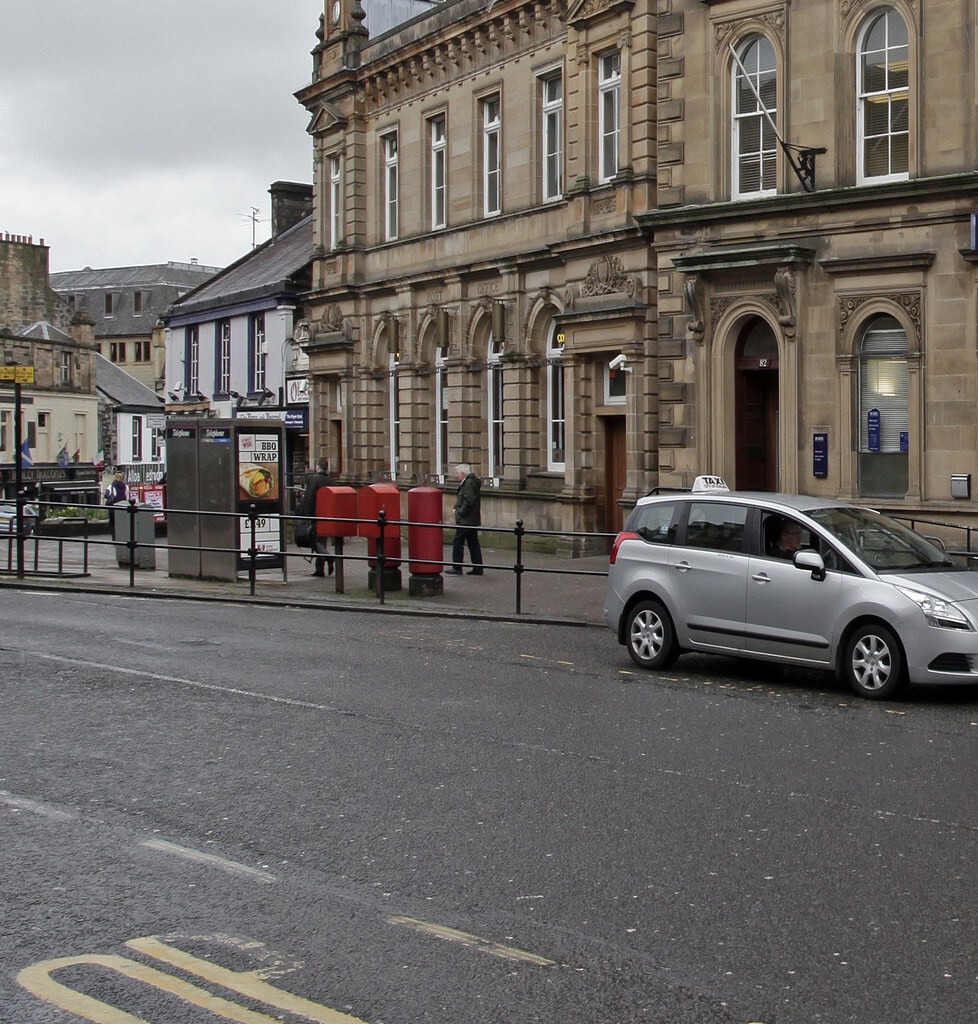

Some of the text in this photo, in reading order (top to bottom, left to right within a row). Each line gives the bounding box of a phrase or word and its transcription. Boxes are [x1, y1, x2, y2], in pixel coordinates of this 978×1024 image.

[759, 358, 767, 367] 82
[172, 428, 190, 438] Telephone
[205, 429, 225, 438] Telephone
[261, 442, 277, 451] BBQ
[253, 452, 277, 462] WRAP
[701, 476, 725, 485] TAXI
